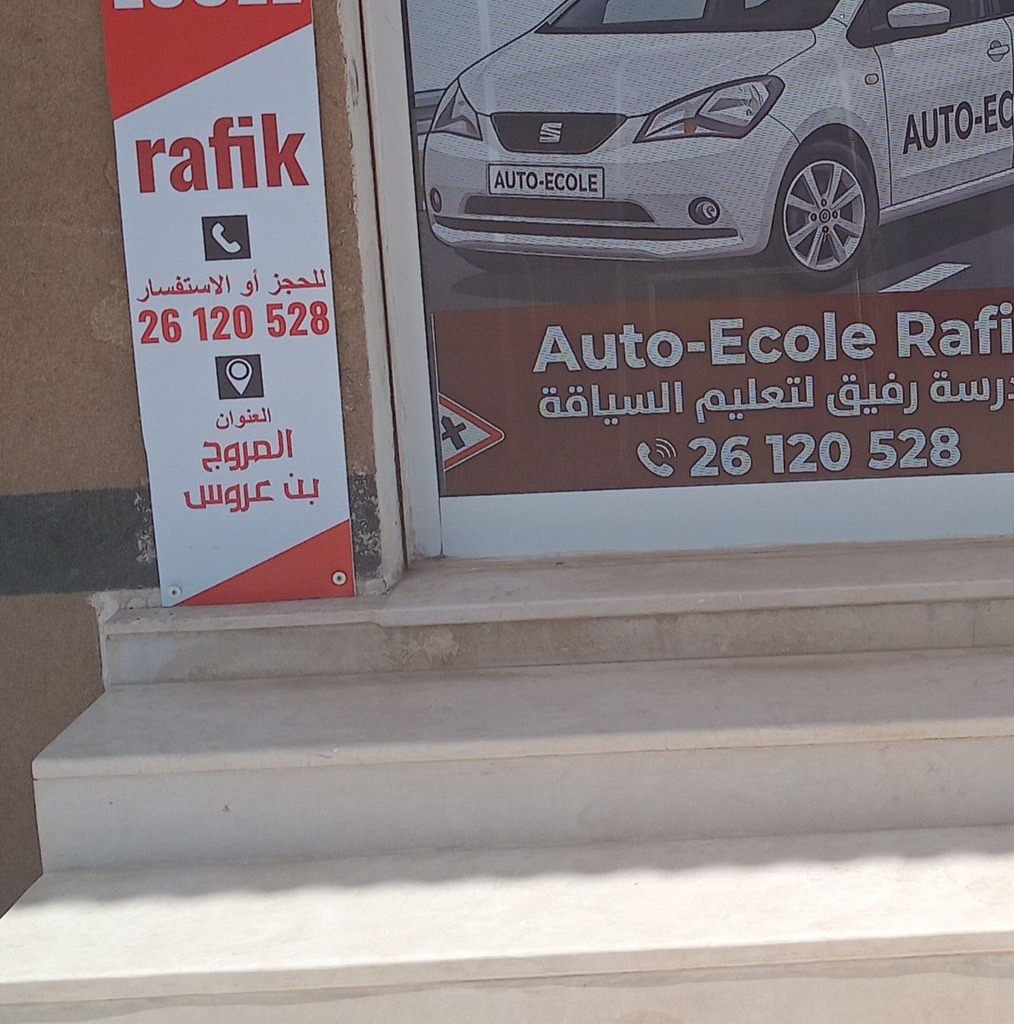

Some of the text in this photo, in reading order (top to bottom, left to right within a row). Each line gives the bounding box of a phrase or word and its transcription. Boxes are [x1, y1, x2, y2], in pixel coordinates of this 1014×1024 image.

[135, 113, 309, 193] rafik
[494, 171, 598, 194] AUTO-ECOLE
[137, 269, 327, 302] للحجز أو الاستفسار
[138, 301, 329, 344] 26 120 528
[533, 312, 876, 373] Auto-Ecole
[538, 382, 683, 426] السياقة
[696, 375, 813, 423] لتعليم
[827, 372, 917, 418] رفيق
[215, 408, 272, 430] العنوان
[202, 428, 292, 472] المروج
[688, 427, 961, 477] 26 120 528
[184, 473, 319, 512] بن عروس
